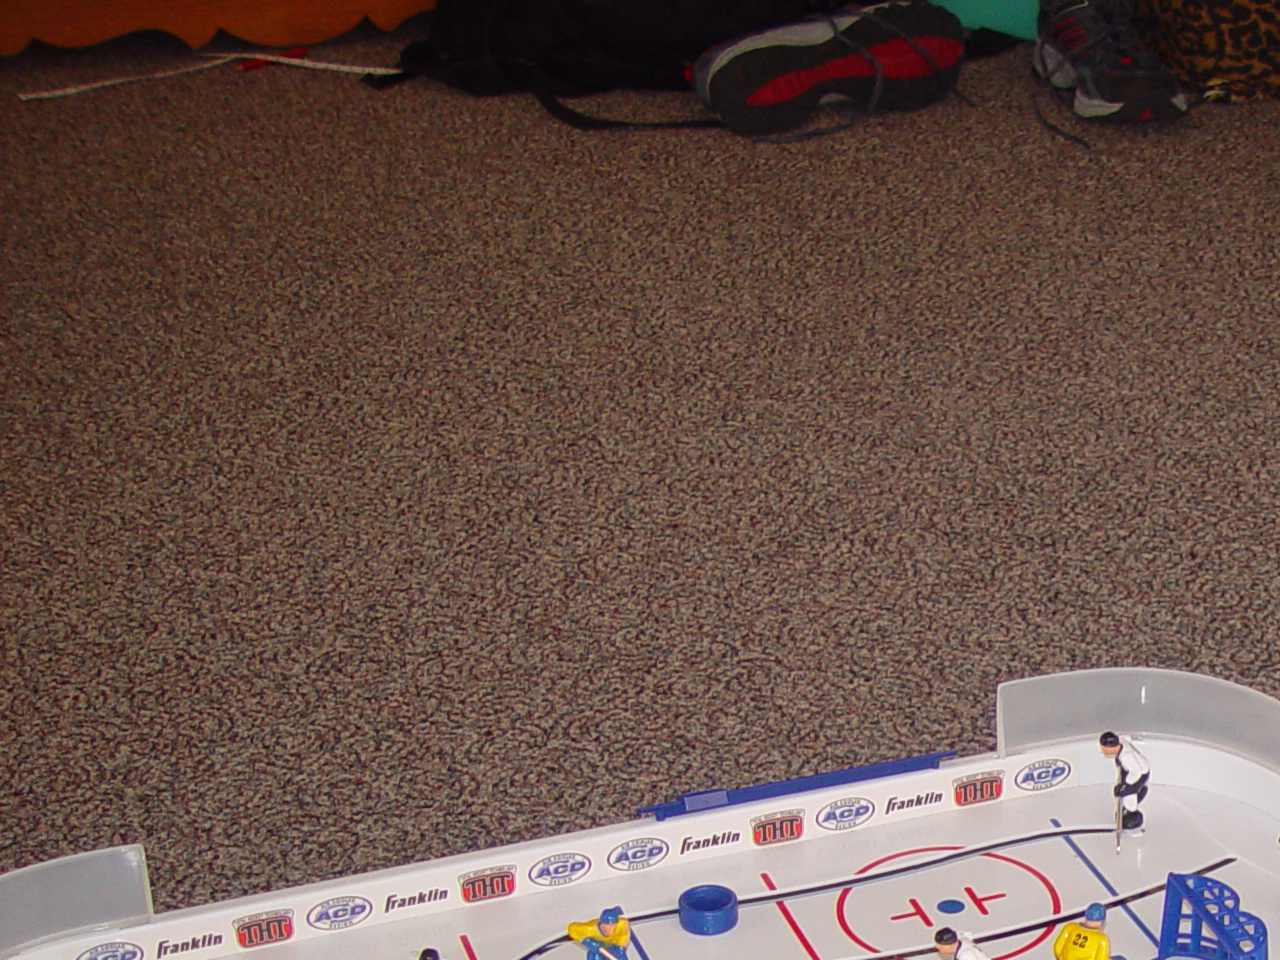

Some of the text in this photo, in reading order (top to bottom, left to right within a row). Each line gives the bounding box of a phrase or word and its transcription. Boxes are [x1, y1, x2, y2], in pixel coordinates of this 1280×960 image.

[1019, 766, 1066, 785] ACD
[959, 778, 1000, 803] THT
[822, 805, 870, 823] ACD
[756, 818, 800, 842] THT
[612, 846, 664, 864] ACD
[534, 861, 586, 879] ACD
[465, 874, 511, 899] THT
[313, 903, 367, 923] ACD
[240, 918, 288, 944] THT
[1072, 932, 1089, 949] 22
